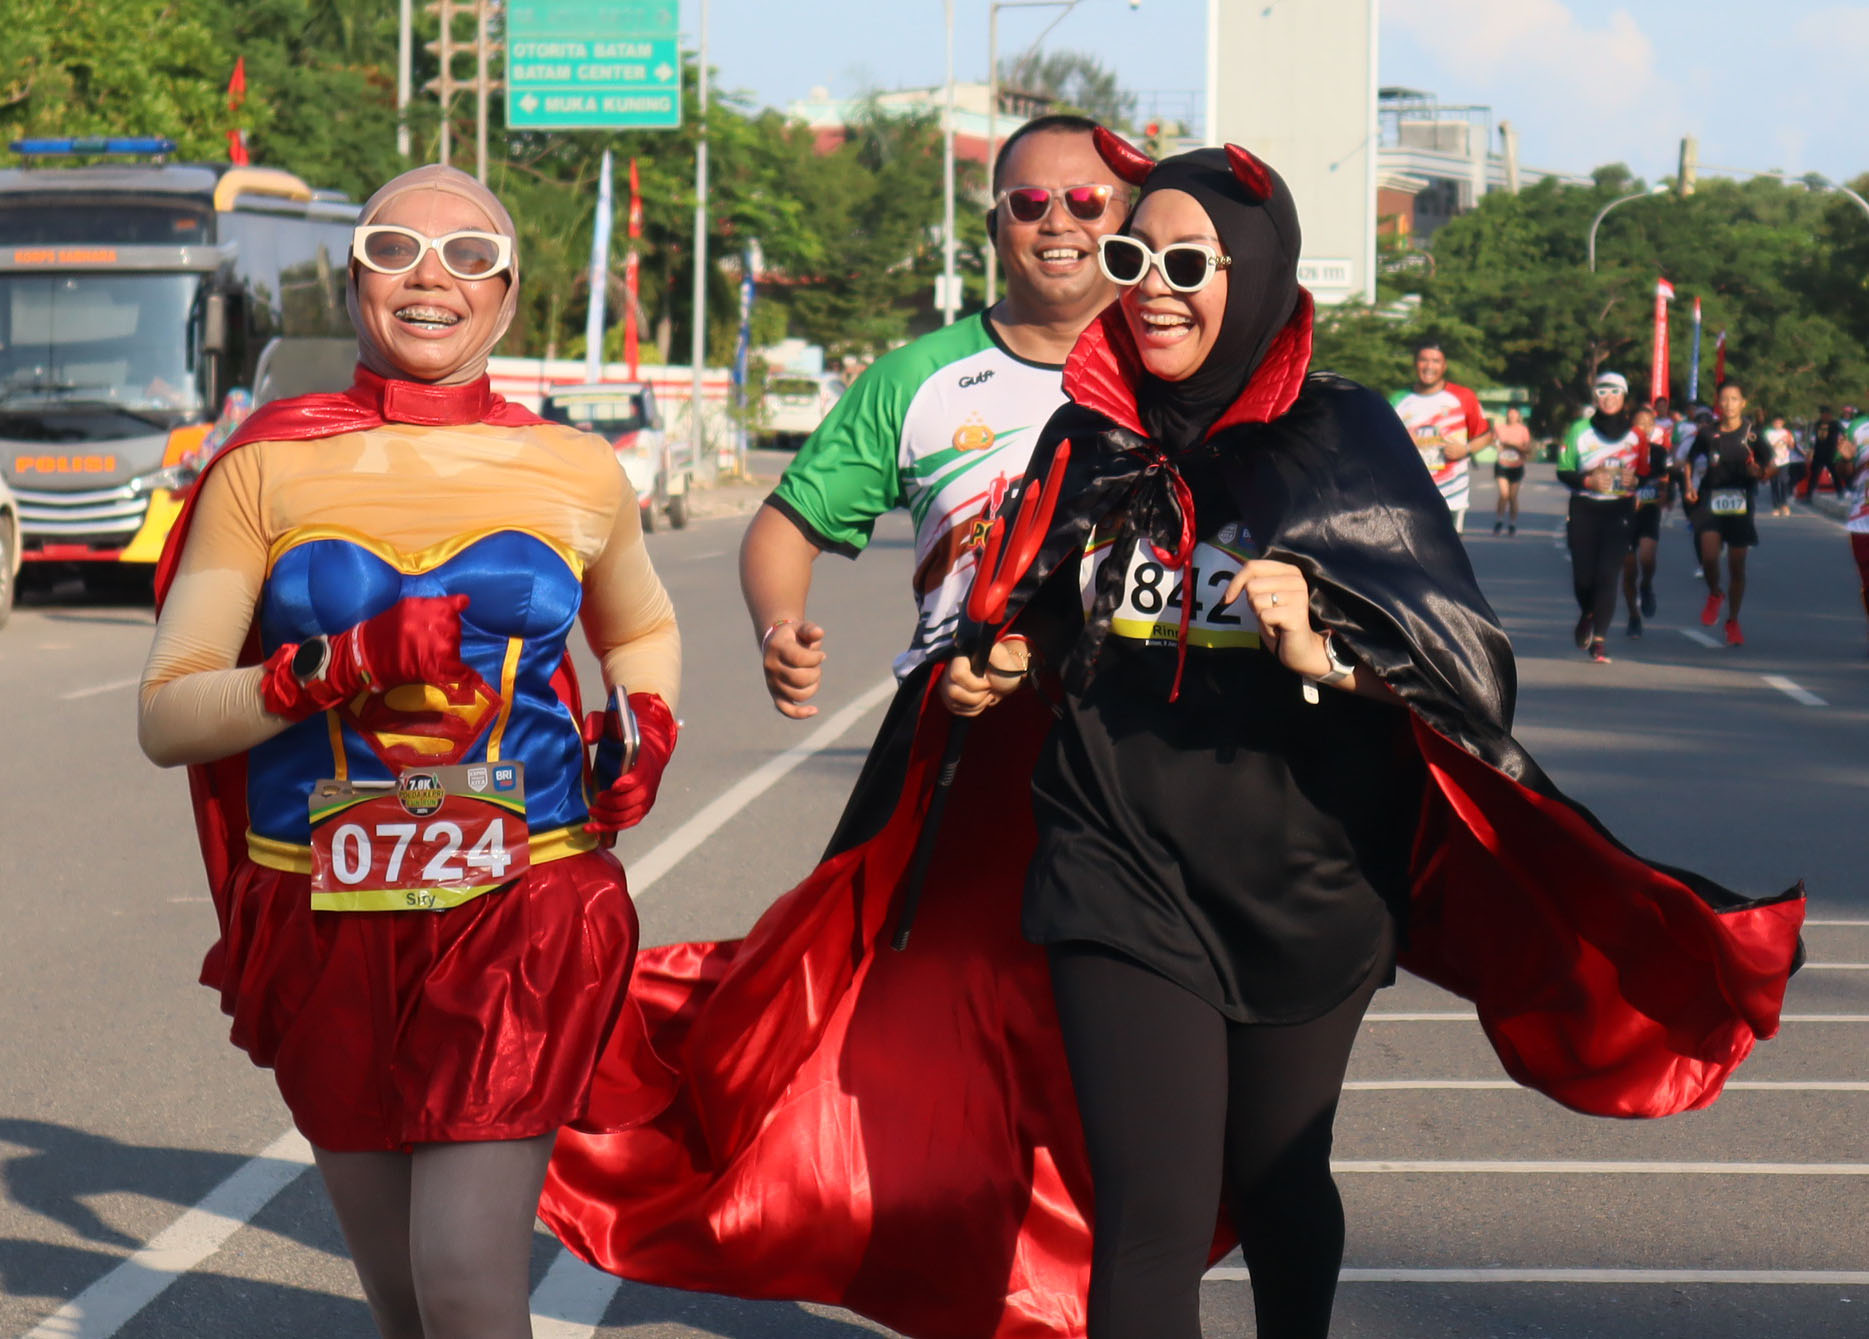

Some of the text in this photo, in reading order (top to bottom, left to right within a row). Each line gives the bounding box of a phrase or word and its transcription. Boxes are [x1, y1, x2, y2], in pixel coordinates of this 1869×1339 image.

[514, 43, 653, 58] OTORITA BATAM
[514, 65, 646, 80] BATAM CENTER
[545, 97, 672, 112] MUKA KUNING
[15, 456, 116, 473] POLISI
[1715, 498, 1744, 510] 1017
[496, 769, 512, 781] BRI
[331, 817, 511, 885] 0724
